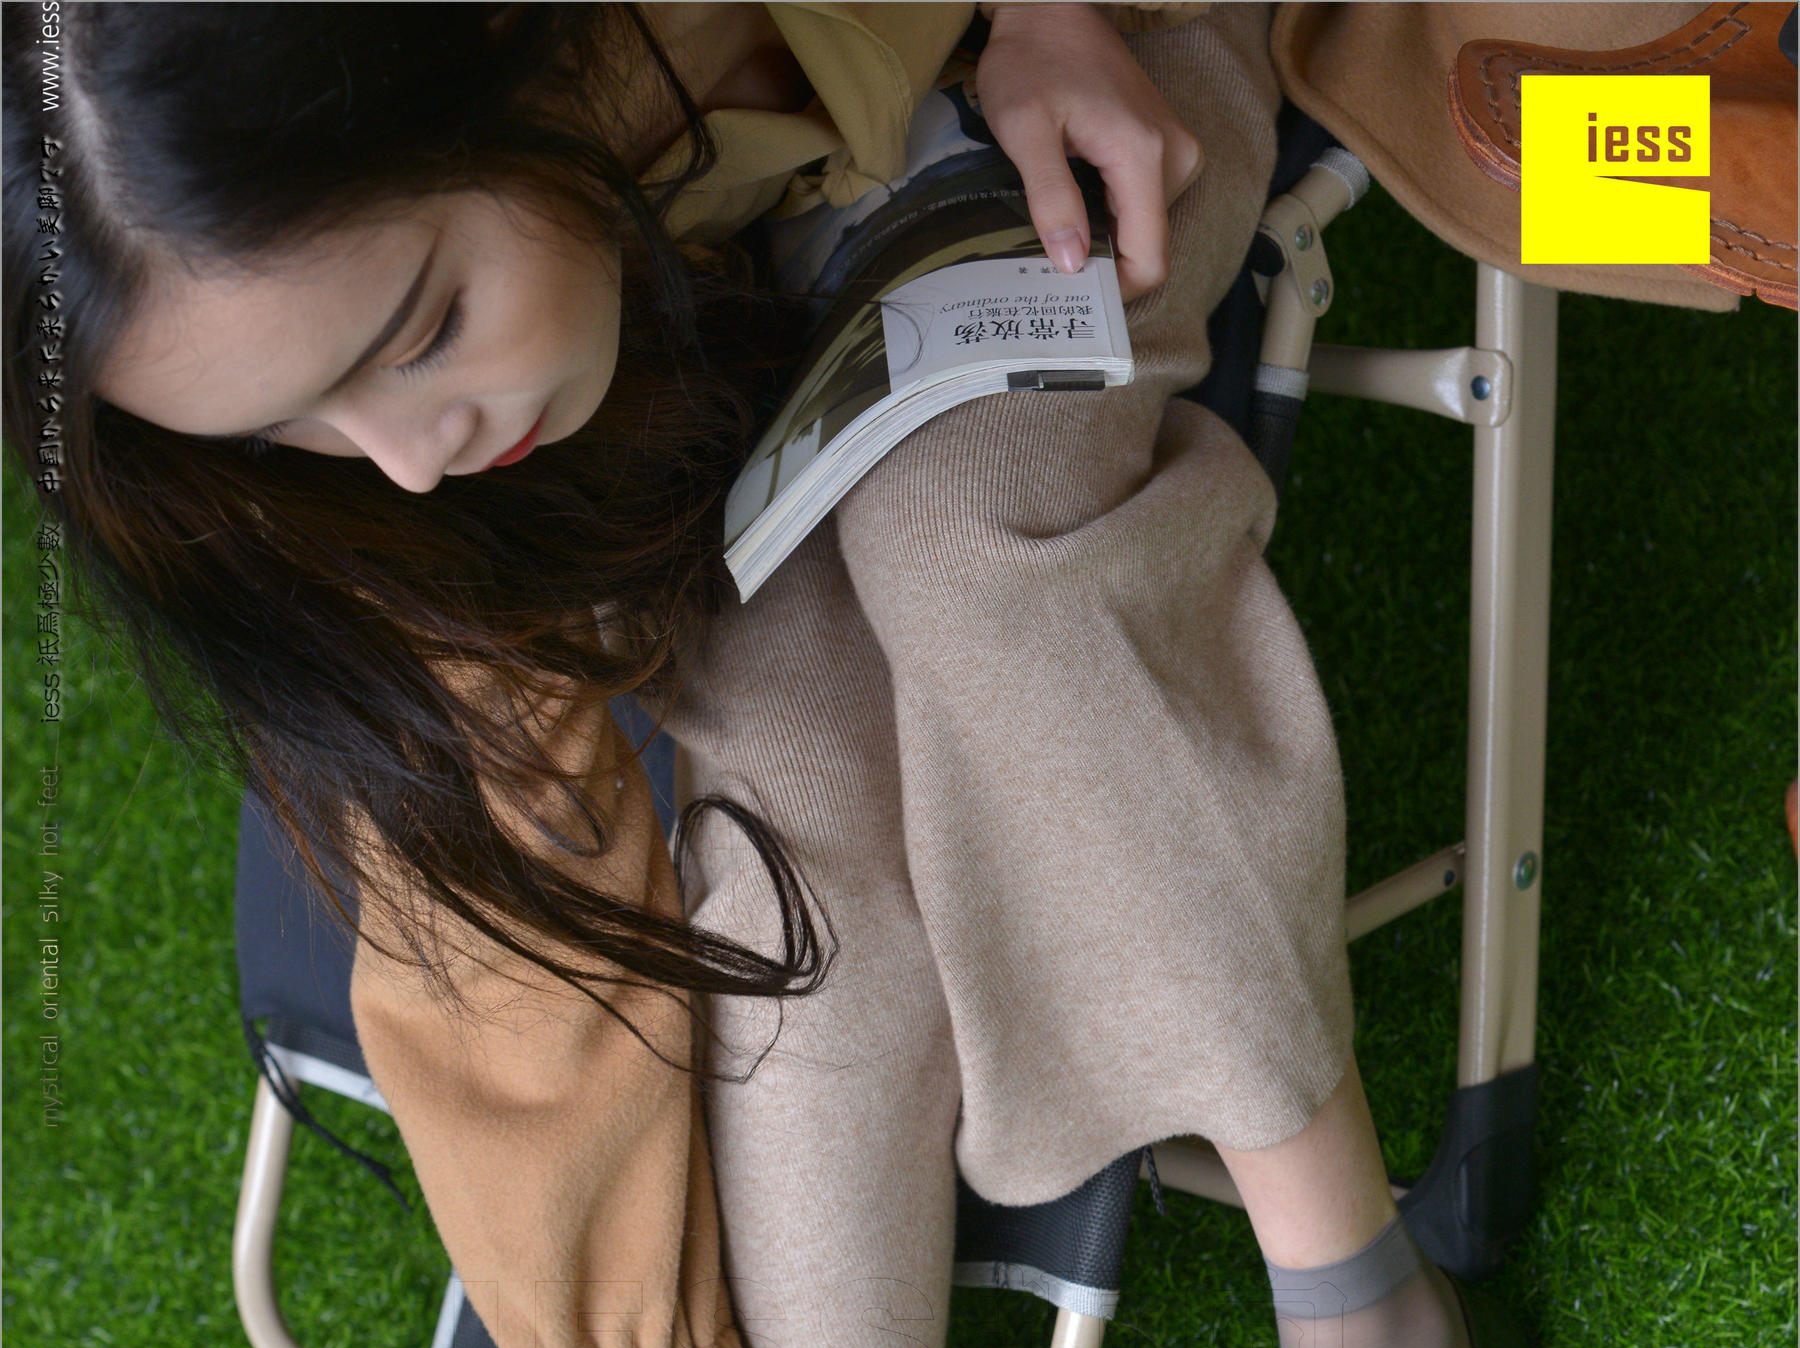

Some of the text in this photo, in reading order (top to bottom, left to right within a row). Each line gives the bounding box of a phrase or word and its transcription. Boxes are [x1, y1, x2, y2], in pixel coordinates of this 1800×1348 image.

[939, 293, 1091, 314] out of the ordinary
[966, 304, 1094, 320] 我的回忆在旅行
[953, 317, 1096, 345] 寻常放荡
